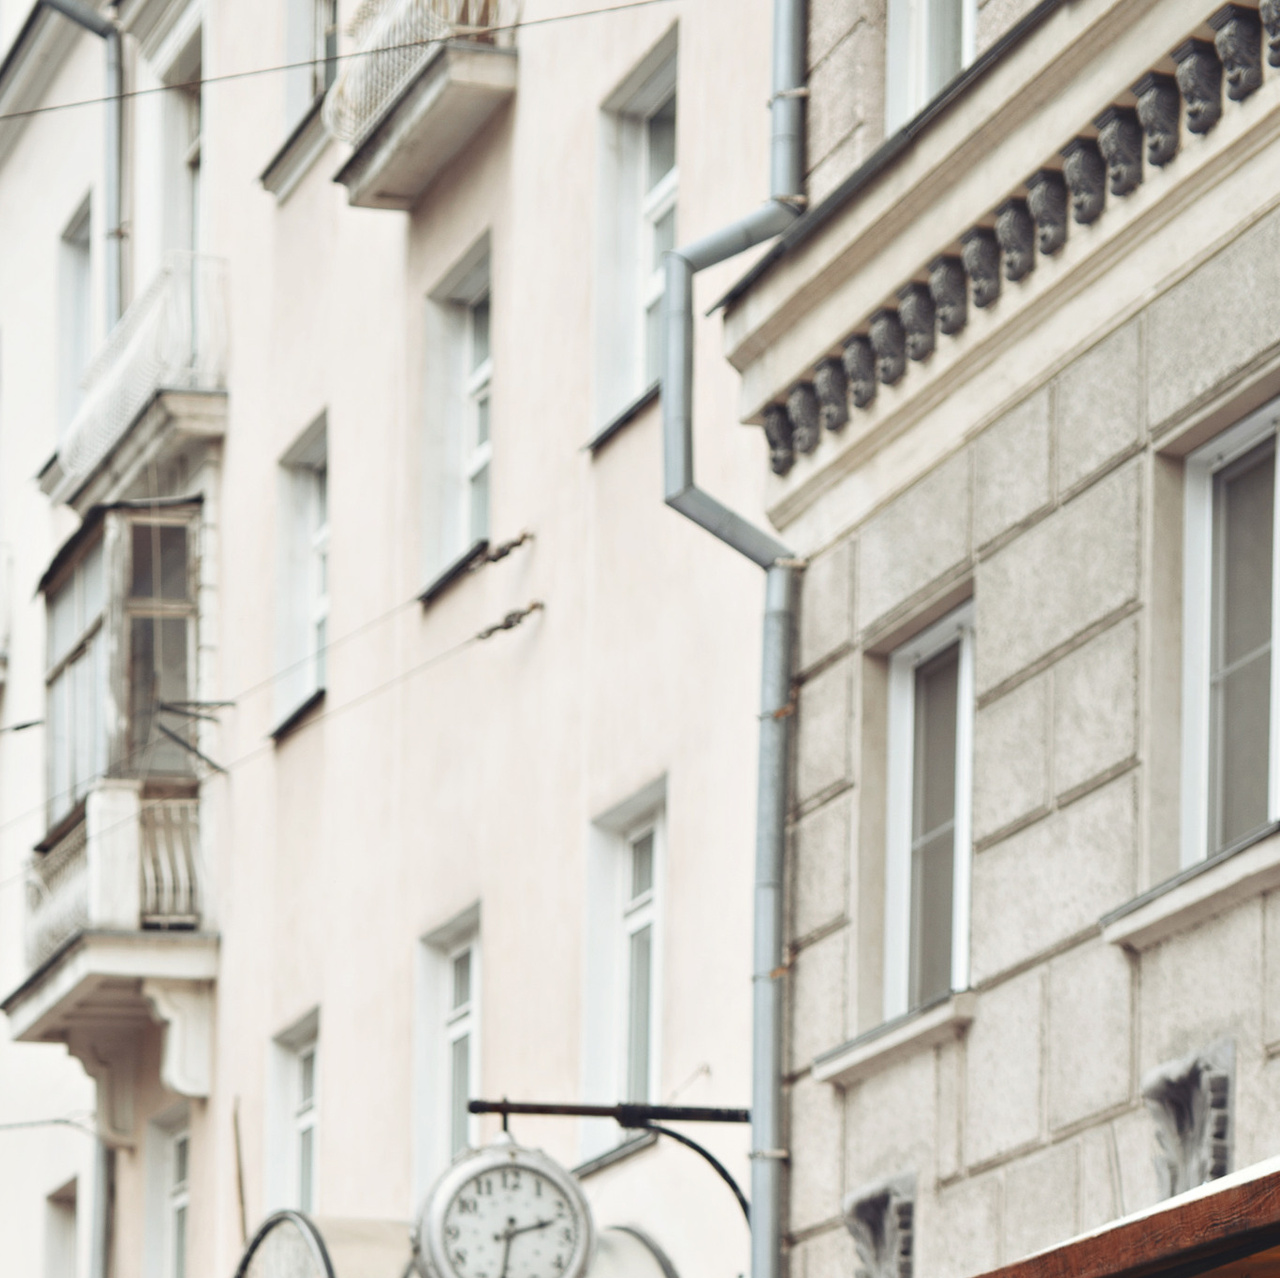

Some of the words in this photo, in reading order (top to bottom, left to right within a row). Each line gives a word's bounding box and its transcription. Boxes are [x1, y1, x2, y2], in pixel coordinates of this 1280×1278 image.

[476, 1178, 492, 1195] 11
[502, 1170, 520, 1190] 12
[535, 1179, 542, 1196] 1
[459, 1199, 477, 1213] 10
